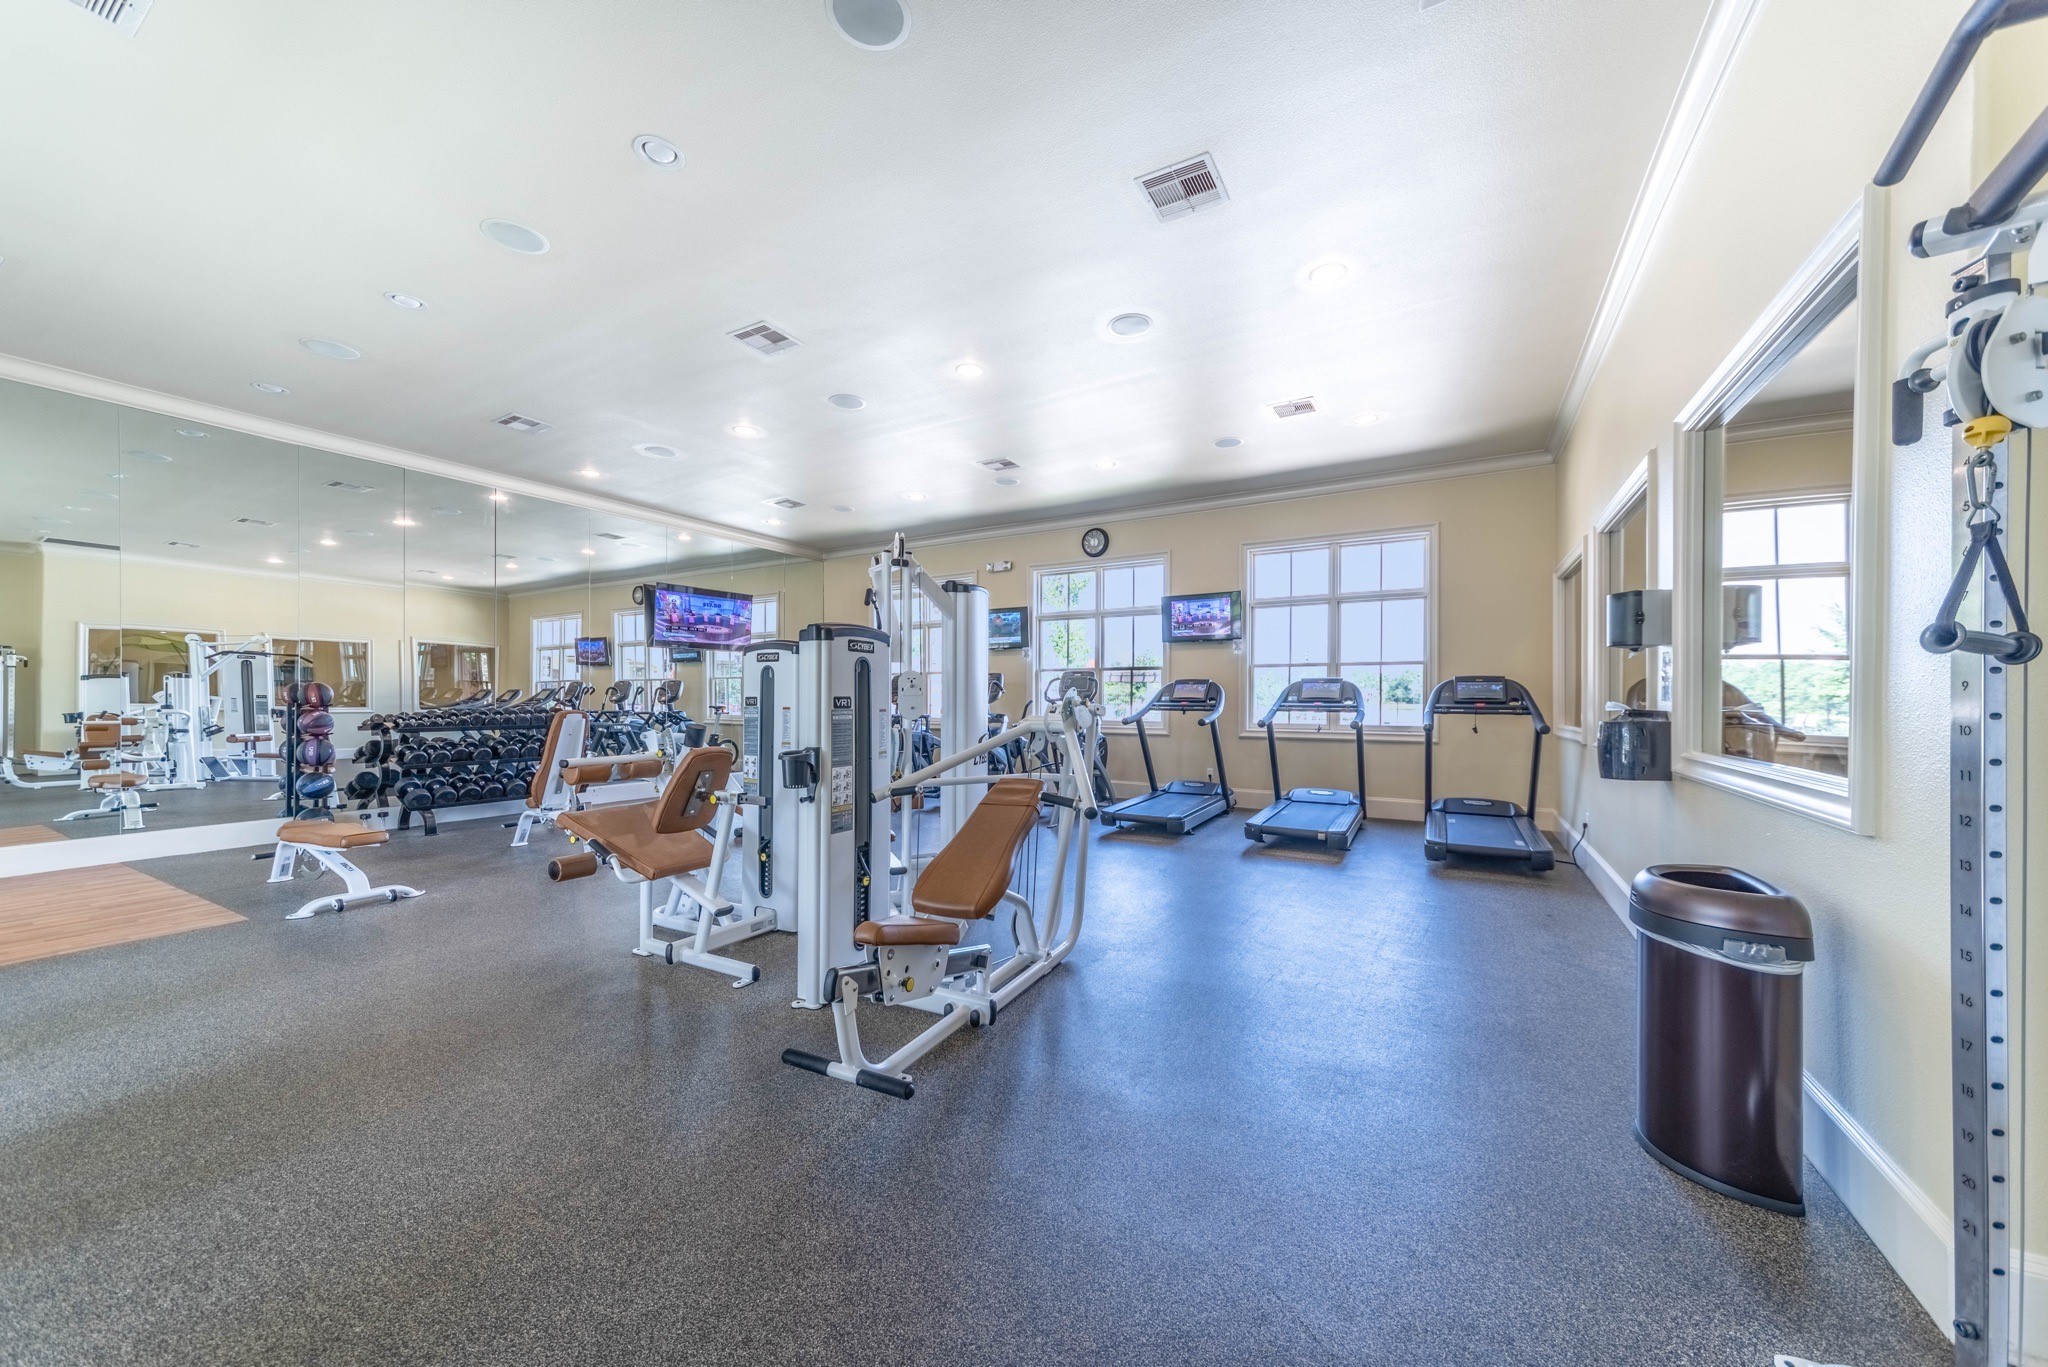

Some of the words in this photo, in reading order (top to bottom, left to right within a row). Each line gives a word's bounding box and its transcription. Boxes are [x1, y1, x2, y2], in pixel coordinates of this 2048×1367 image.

[1962, 500, 1970, 512] 5
[1961, 680, 1970, 691] 9
[835, 698, 851, 707] VR1
[1958, 725, 1972, 736] 10
[1959, 770, 1972, 782] 11
[1958, 814, 1972, 827] 12
[1959, 859, 1972, 872] 13
[1959, 903, 1972, 918] 14
[1959, 948, 1973, 962] 15
[1960, 993, 1973, 1008] 16
[1960, 1037, 1973, 1051] 17
[1961, 1083, 1974, 1099] 18
[1961, 1128, 1975, 1143] 19
[1961, 1173, 1976, 1190] 20
[1962, 1218, 1977, 1236] 21
